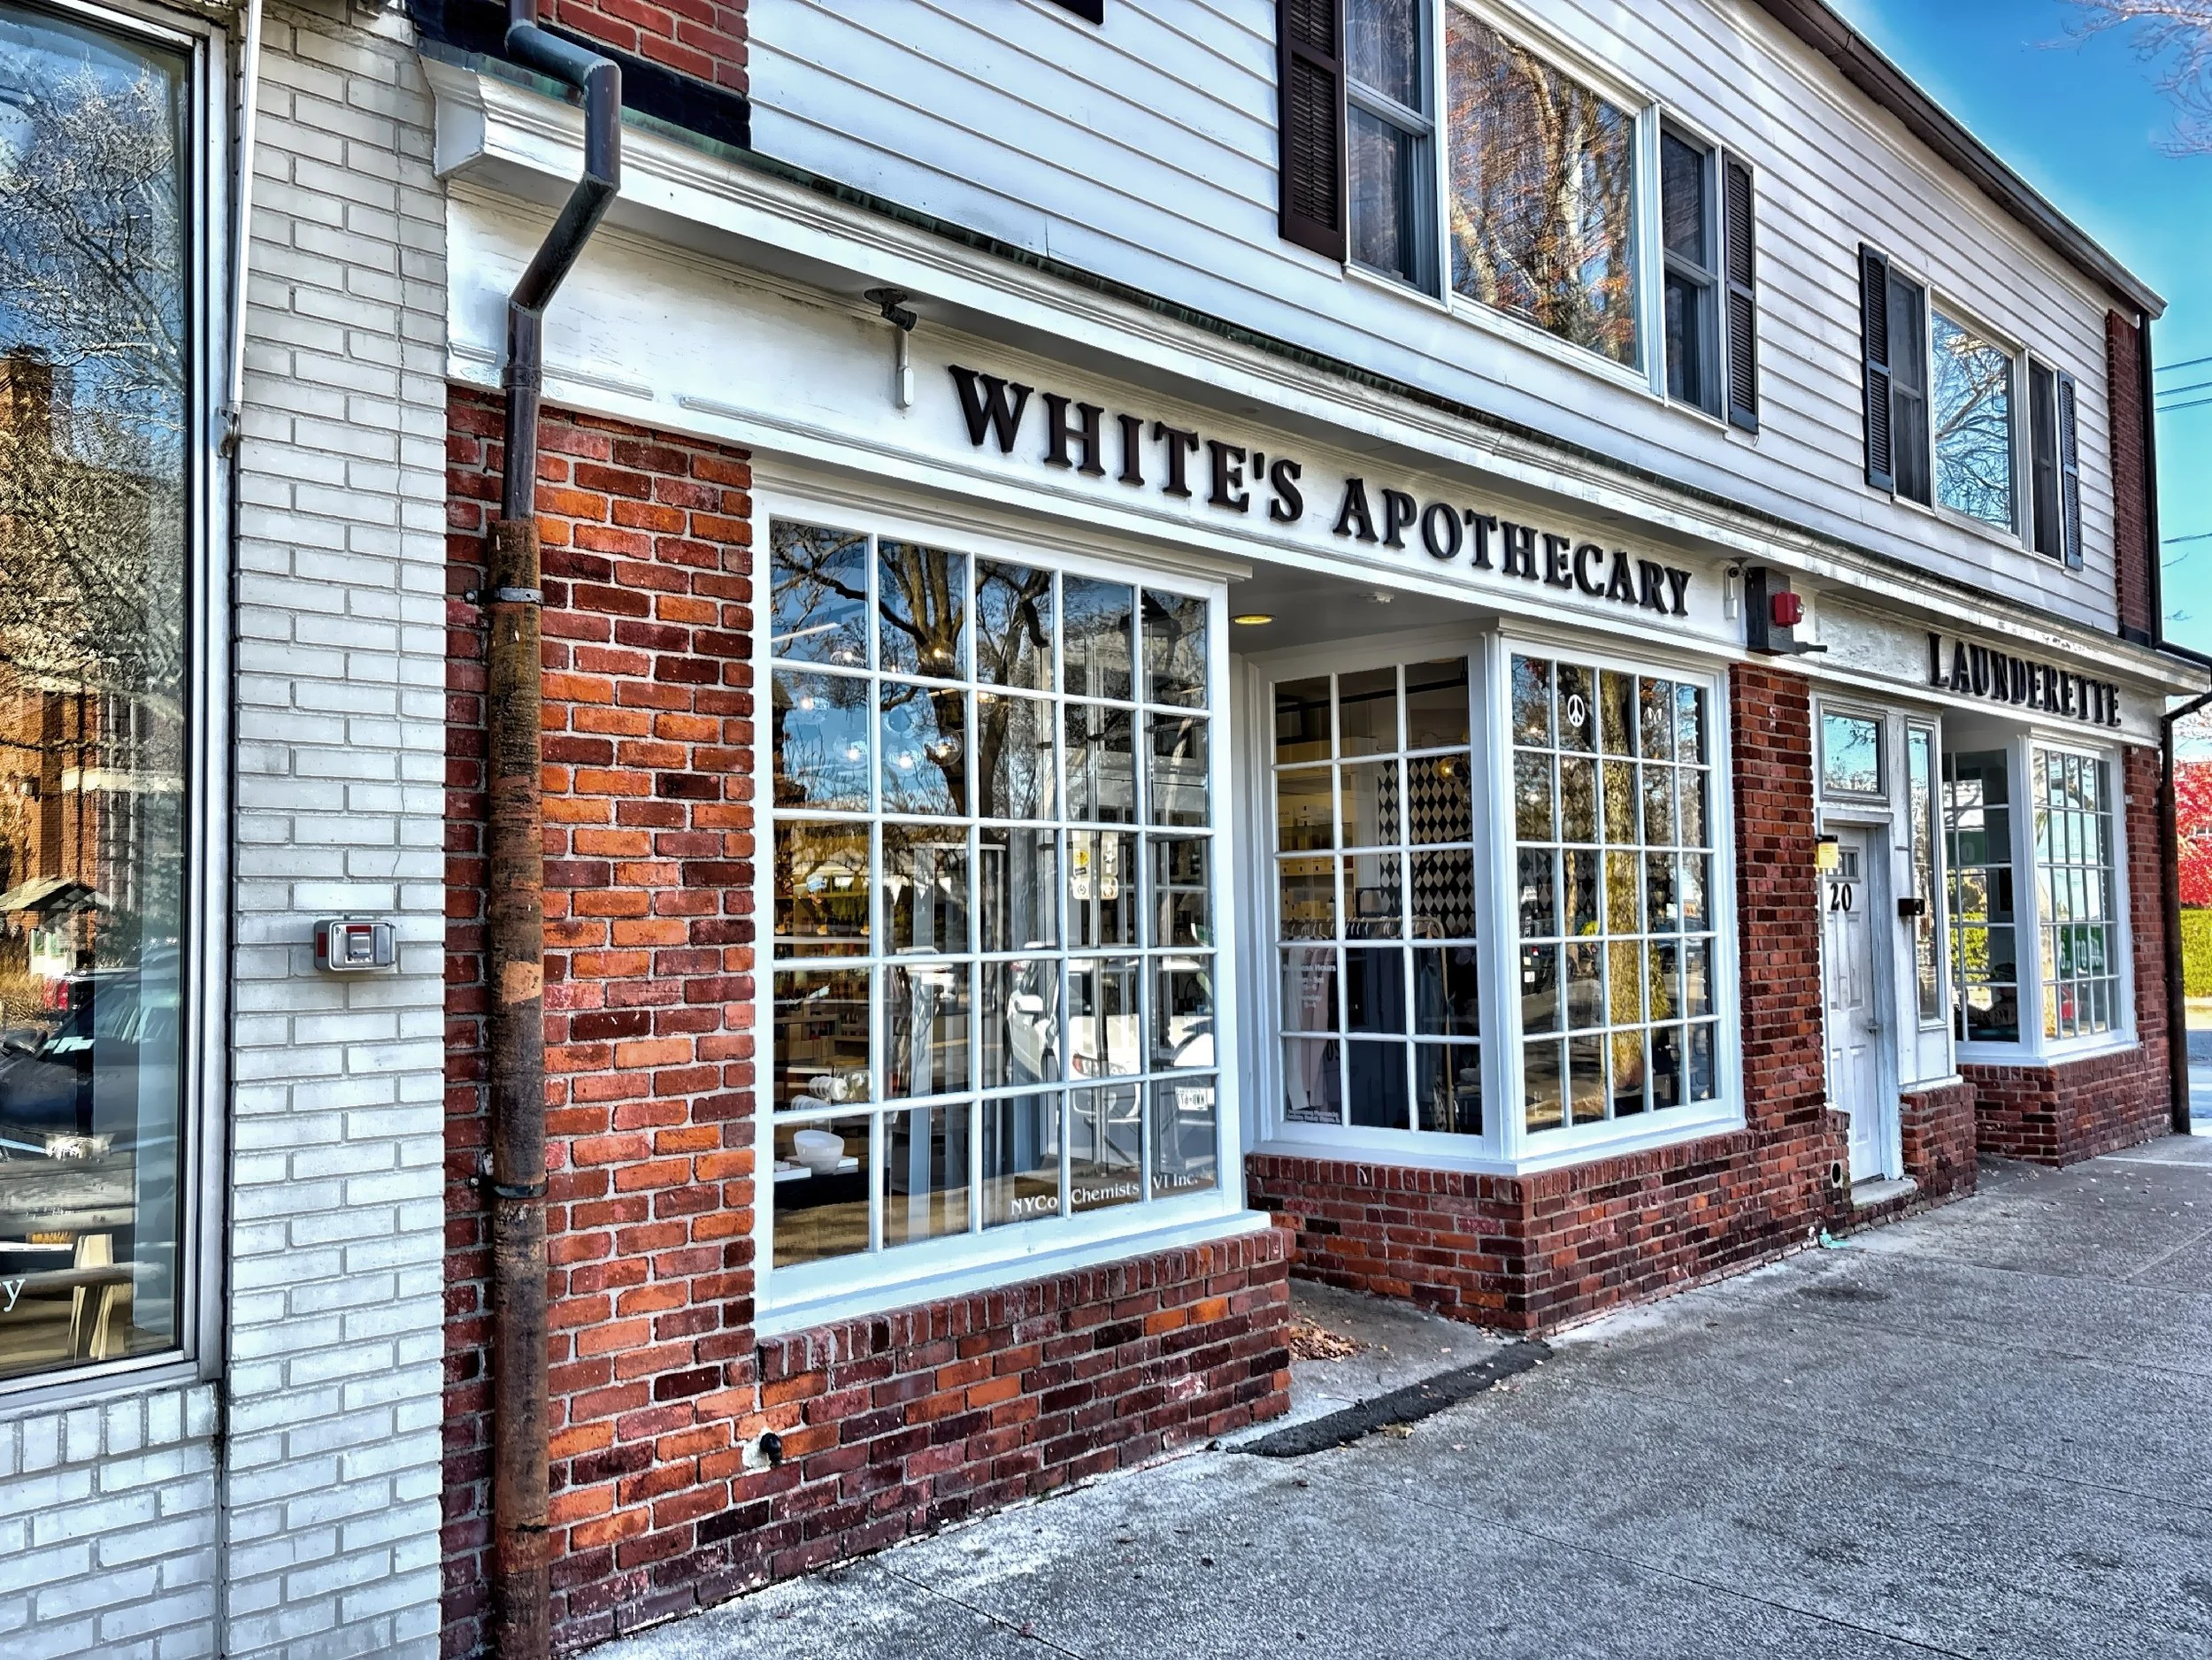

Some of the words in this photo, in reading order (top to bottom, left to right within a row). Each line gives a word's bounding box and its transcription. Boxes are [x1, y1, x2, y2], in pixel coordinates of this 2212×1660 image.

[948, 365, 1304, 523] WHITE'S
[1333, 478, 1694, 617] APOTHECARY
[1927, 633, 2122, 727] LAUNDERETTE
[1830, 882, 1853, 912] 20
[1071, 1181, 1140, 1205] Chemists
[1153, 1174, 1169, 1190] VI
[1173, 1172, 1198, 1187] Inc.
[0, 1278, 27, 1312] y
